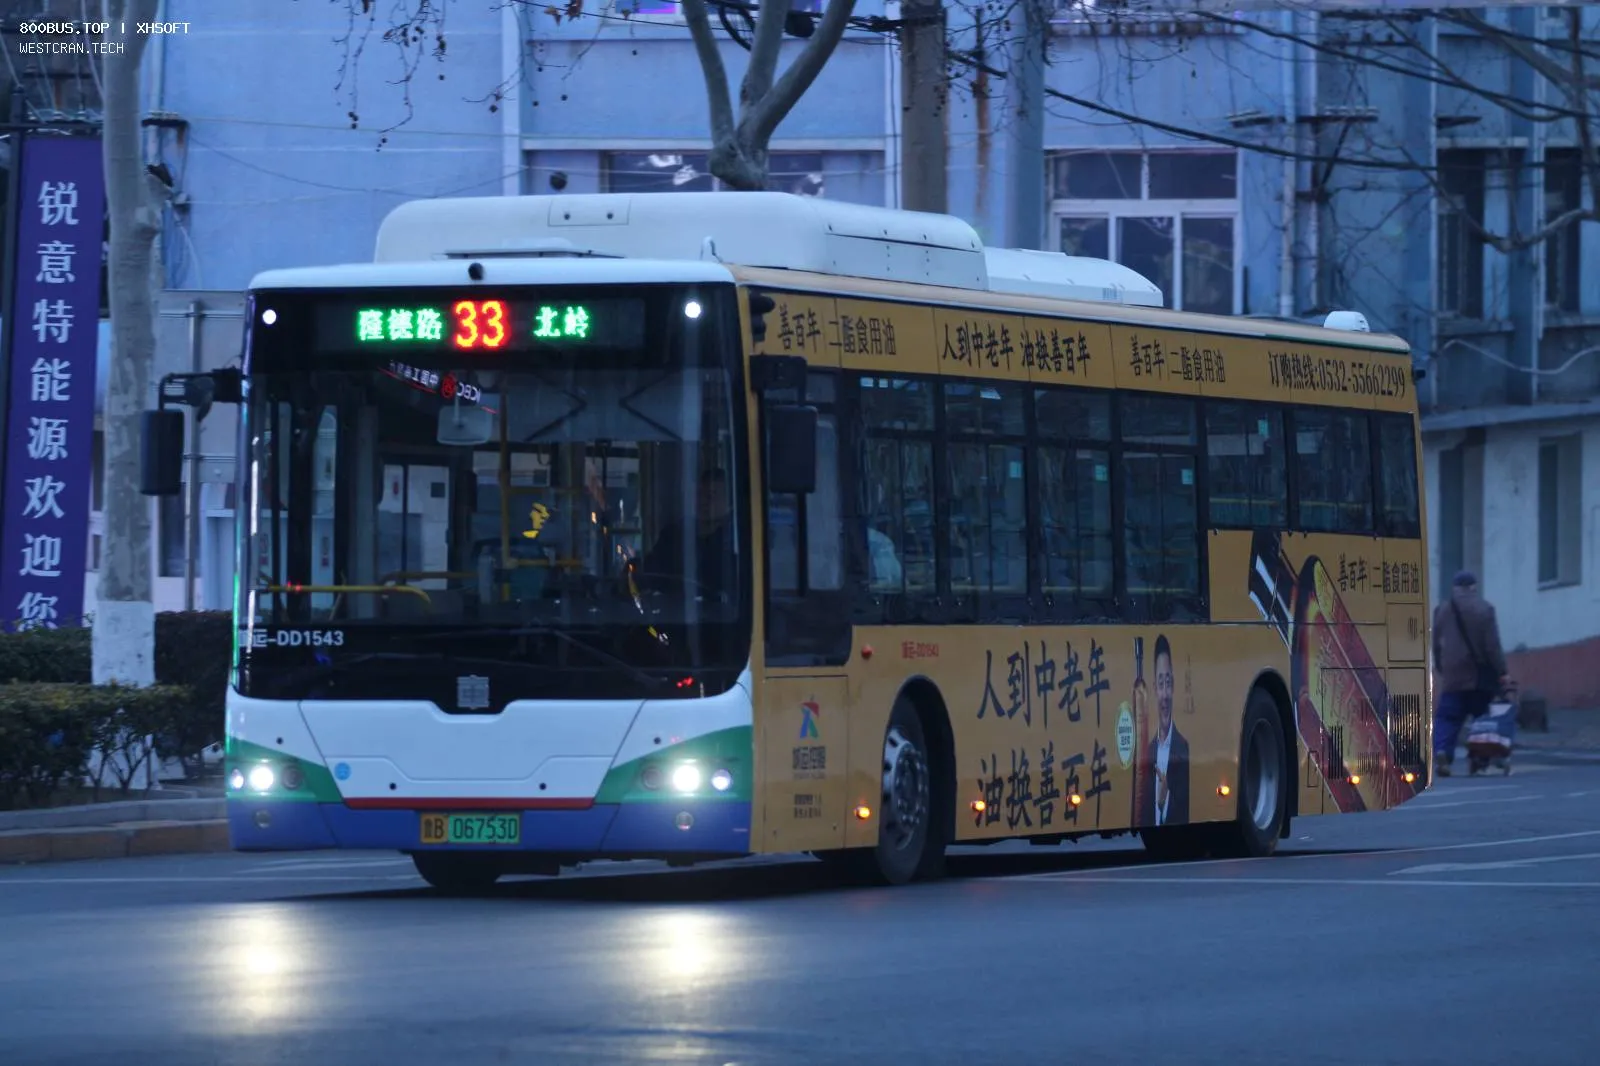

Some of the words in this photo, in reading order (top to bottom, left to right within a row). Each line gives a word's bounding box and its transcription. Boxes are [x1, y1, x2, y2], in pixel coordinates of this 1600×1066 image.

[454, 300, 505, 348] 33
[533, 305, 590, 338] 北岭
[777, 304, 821, 353] 善百年
[942, 321, 1014, 370] 人到中老年
[1019, 329, 1091, 378] 油换善百年
[1129, 335, 1165, 381] 善百年
[17, 180, 79, 633] 锐意特能源欢迎您
[1337, 554, 1368, 593] 善百年
[976, 637, 1111, 729] 人到中老年
[973, 738, 1112, 831] 油换善百年
